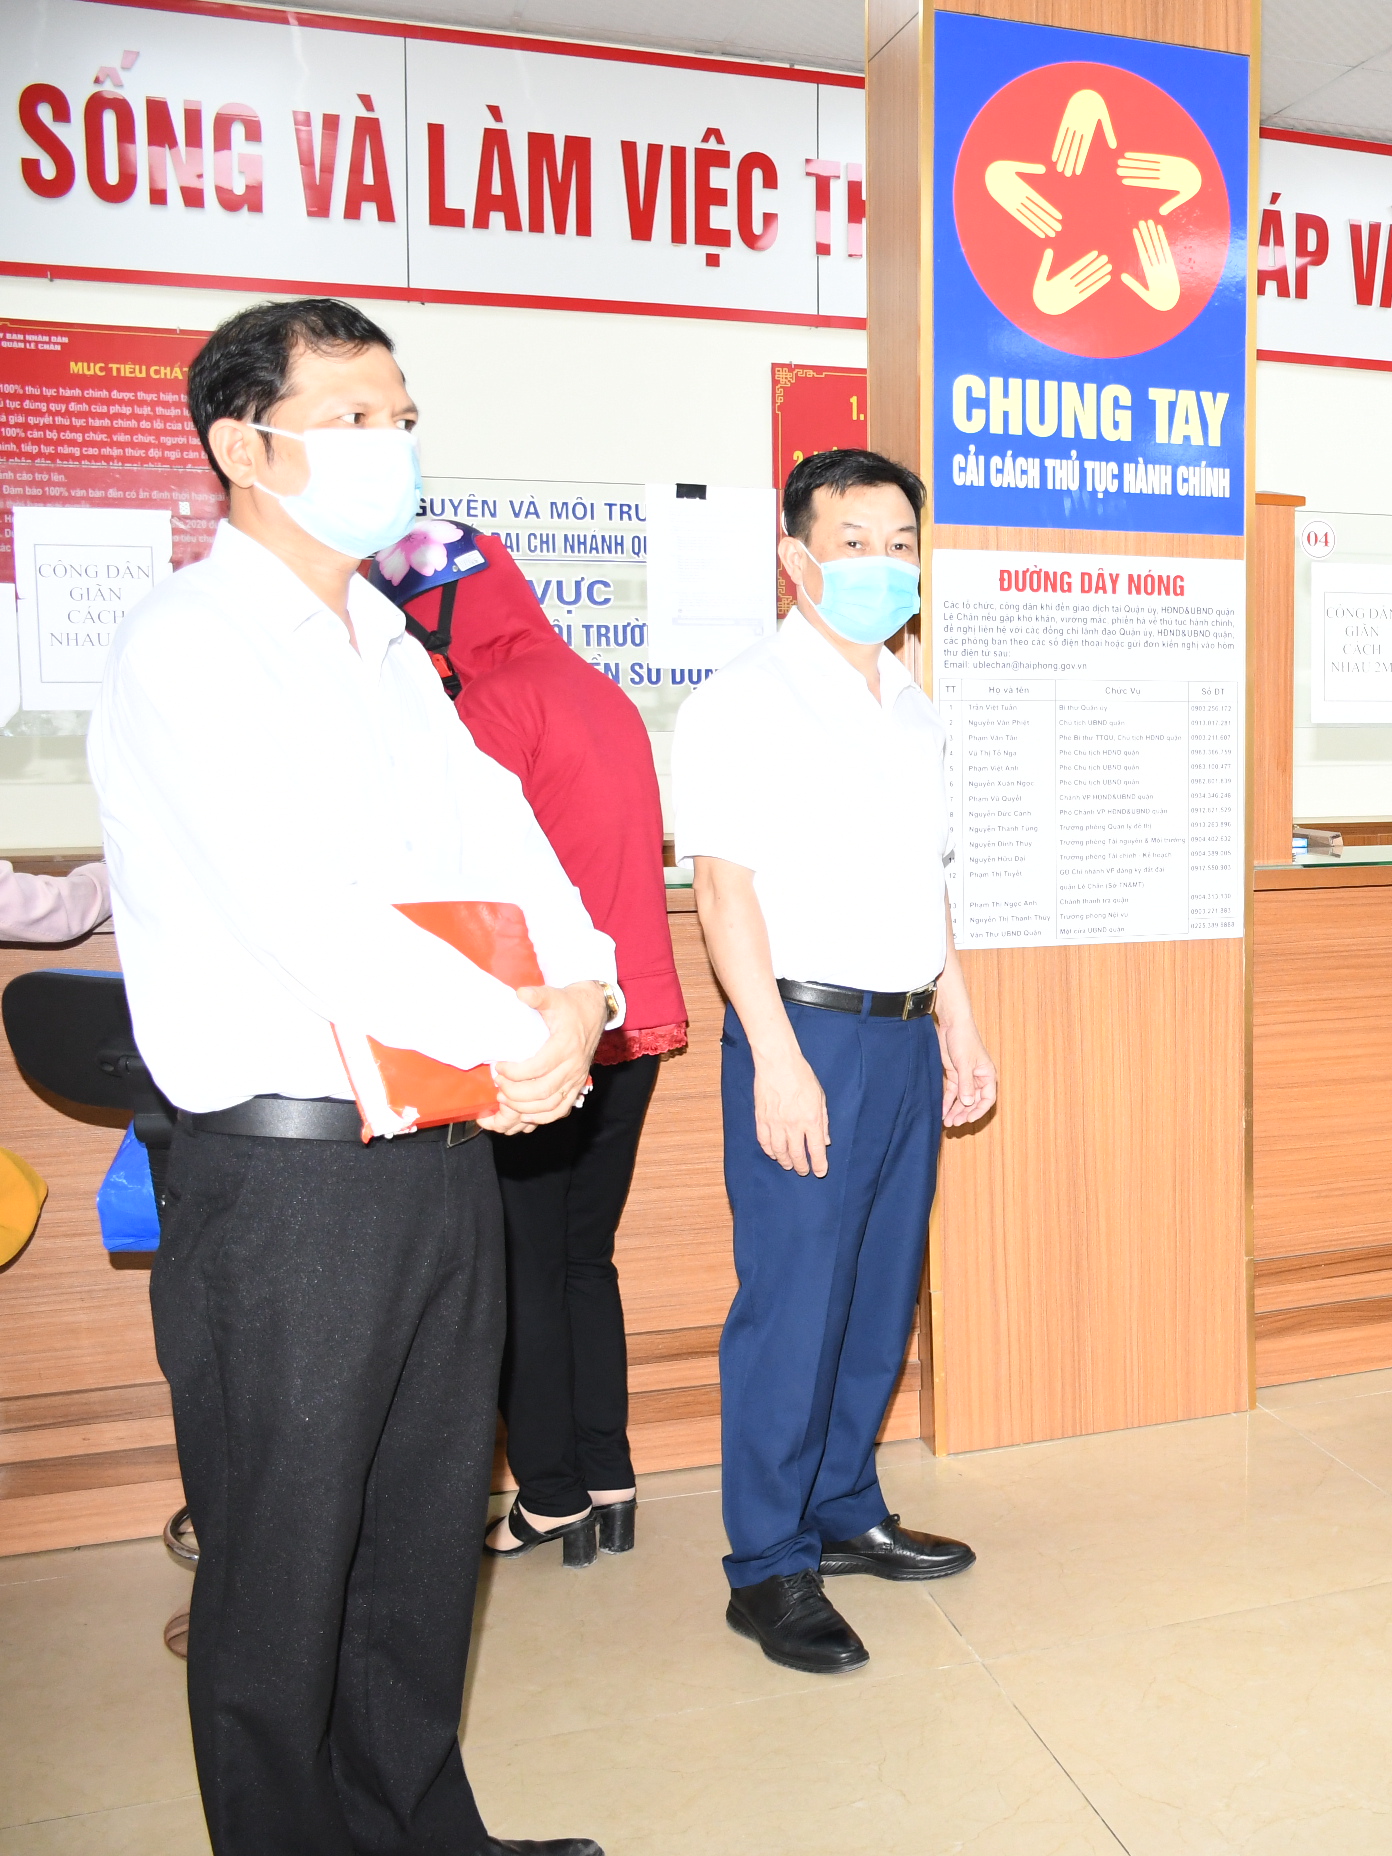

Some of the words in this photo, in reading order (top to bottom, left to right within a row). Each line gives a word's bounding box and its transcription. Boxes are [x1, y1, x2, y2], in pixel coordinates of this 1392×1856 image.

[19, 49, 264, 214] SỐNG
[292, 94, 397, 224] VÀ
[427, 104, 593, 239] LÀM
[620, 128, 779, 268] VIỆC
[70, 362, 105, 377] MỤC
[109, 362, 146, 377] TIÊU
[26, 386, 40, 394] thủ
[43, 387, 57, 397] tục
[59, 387, 82, 396] hành
[84, 388, 108, 398] chính
[111, 390, 135, 401] được
[137, 392, 157, 402] thực
[160, 392, 178, 403] hiện
[6, 400, 21, 410] tục
[23, 400, 47, 411] đúng
[50, 402, 66, 412] quy
[69, 402, 88, 413] định
[91, 404, 107, 412] của
[110, 404, 132, 415] pháp
[134, 405, 153, 416] luật,
[156, 407, 181, 417] thuận
[850, 395, 864, 420] 1.
[953, 374, 1132, 442] CHUNG
[1148, 387, 1229, 447] TAY
[9, 414, 25, 425] giải
[28, 412, 52, 426] quyết
[55, 415, 70, 425] thủ
[72, 417, 86, 427] tục
[89, 417, 110, 426] hành
[113, 419, 137, 428] chính
[140, 420, 151, 428] do
[166, 422, 182, 430] của
[1, 428, 25, 438] 100%
[27, 430, 44, 438] cán
[46, 430, 57, 441] bộ
[60, 431, 82, 442] công
[85, 432, 110, 442] chức,
[112, 433, 131, 441] viên
[133, 434, 157, 444] chức,
[160, 436, 186, 445] người
[21, 442, 38, 454] tiếp
[41, 443, 55, 455] tục
[58, 445, 80, 456] nâng
[101, 447, 123, 457] nhận
[125, 447, 146, 457] thức
[148, 448, 162, 459] đội
[164, 450, 181, 459] ngũ
[183, 451, 199, 459] cán
[51, 473, 67, 482] lên.
[953, 444, 984, 487] CẢI
[990, 450, 1039, 489] CÁCH
[1045, 450, 1079, 491] THỦ
[1085, 460, 1118, 499] TỤC
[1124, 457, 1172, 495] HÀNH
[1177, 461, 1230, 498] CHÍNH
[25, 486, 42, 495] bảo
[45, 487, 68, 496] 100%
[89, 488, 105, 498] bản
[126, 489, 135, 498] có
[152, 491, 170, 500] định
[509, 495, 541, 519] VÀ
[550, 497, 594, 520] MÔI
[528, 533, 556, 553] CHI
[564, 530, 624, 555] NHÁNH
[1306, 530, 1330, 548] 04
[38, 560, 98, 578] CÔNG
[107, 561, 150, 579] DÂN
[999, 565, 1072, 594] ĐƯỜNG
[1080, 567, 1119, 595] DÂY
[1128, 569, 1185, 597] NÓNG
[69, 584, 122, 602] GIÃN
[944, 600, 959, 609] Các
[999, 602, 1020, 612] công
[1072, 605, 1089, 614] giao
[1326, 606, 1365, 619] CÔNG
[944, 613, 954, 621] Lê
[1345, 623, 1380, 637] GIÃN
[50, 633, 110, 647] NHAU
[944, 637, 958, 645] các
[1032, 638, 1045, 646] các
[1049, 637, 1058, 646] số
[1342, 641, 1381, 655] CÁCH
[961, 649, 978, 658] điện
[944, 660, 970, 669] Email:
[1331, 662, 1371, 673] NHAU
[1374, 662, 1392, 673] 2M
[1105, 686, 1127, 695] Chức
[1130, 687, 1141, 696] Vụ
